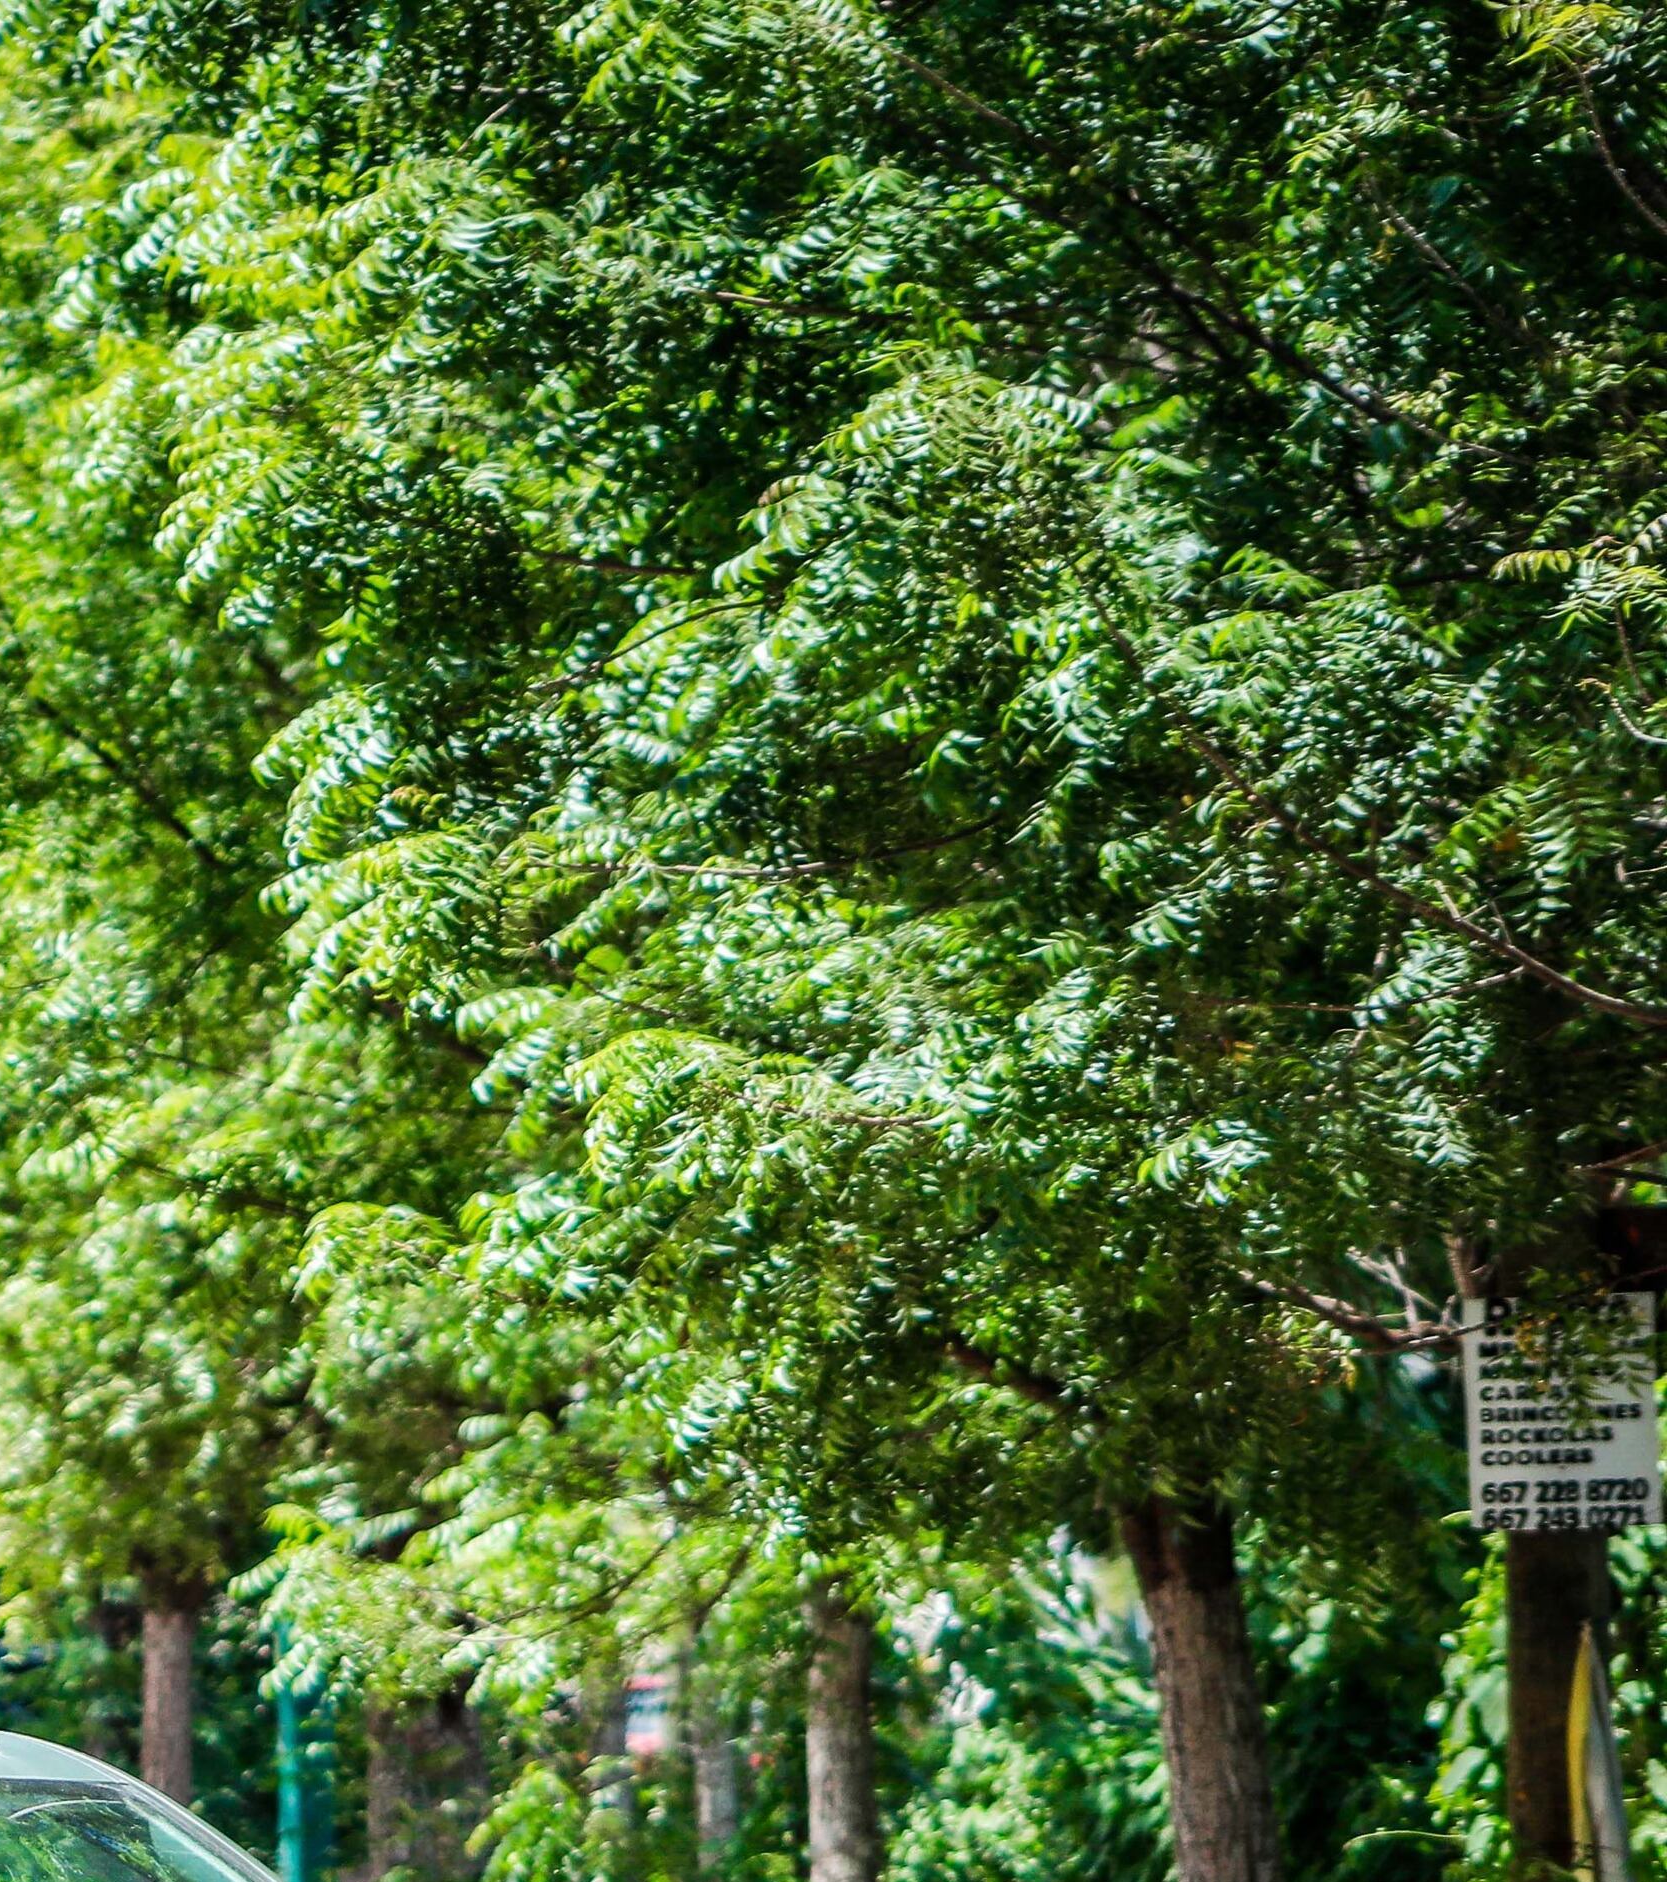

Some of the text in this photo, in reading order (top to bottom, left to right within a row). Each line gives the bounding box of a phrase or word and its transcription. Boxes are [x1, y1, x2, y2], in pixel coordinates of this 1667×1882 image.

[1480, 1425, 1615, 1445] ROCKOLAS
[1480, 1447, 1594, 1466] COOLERS
[1481, 1476, 1650, 1503] 667 228 8720
[1481, 1507, 1529, 1529] 667
